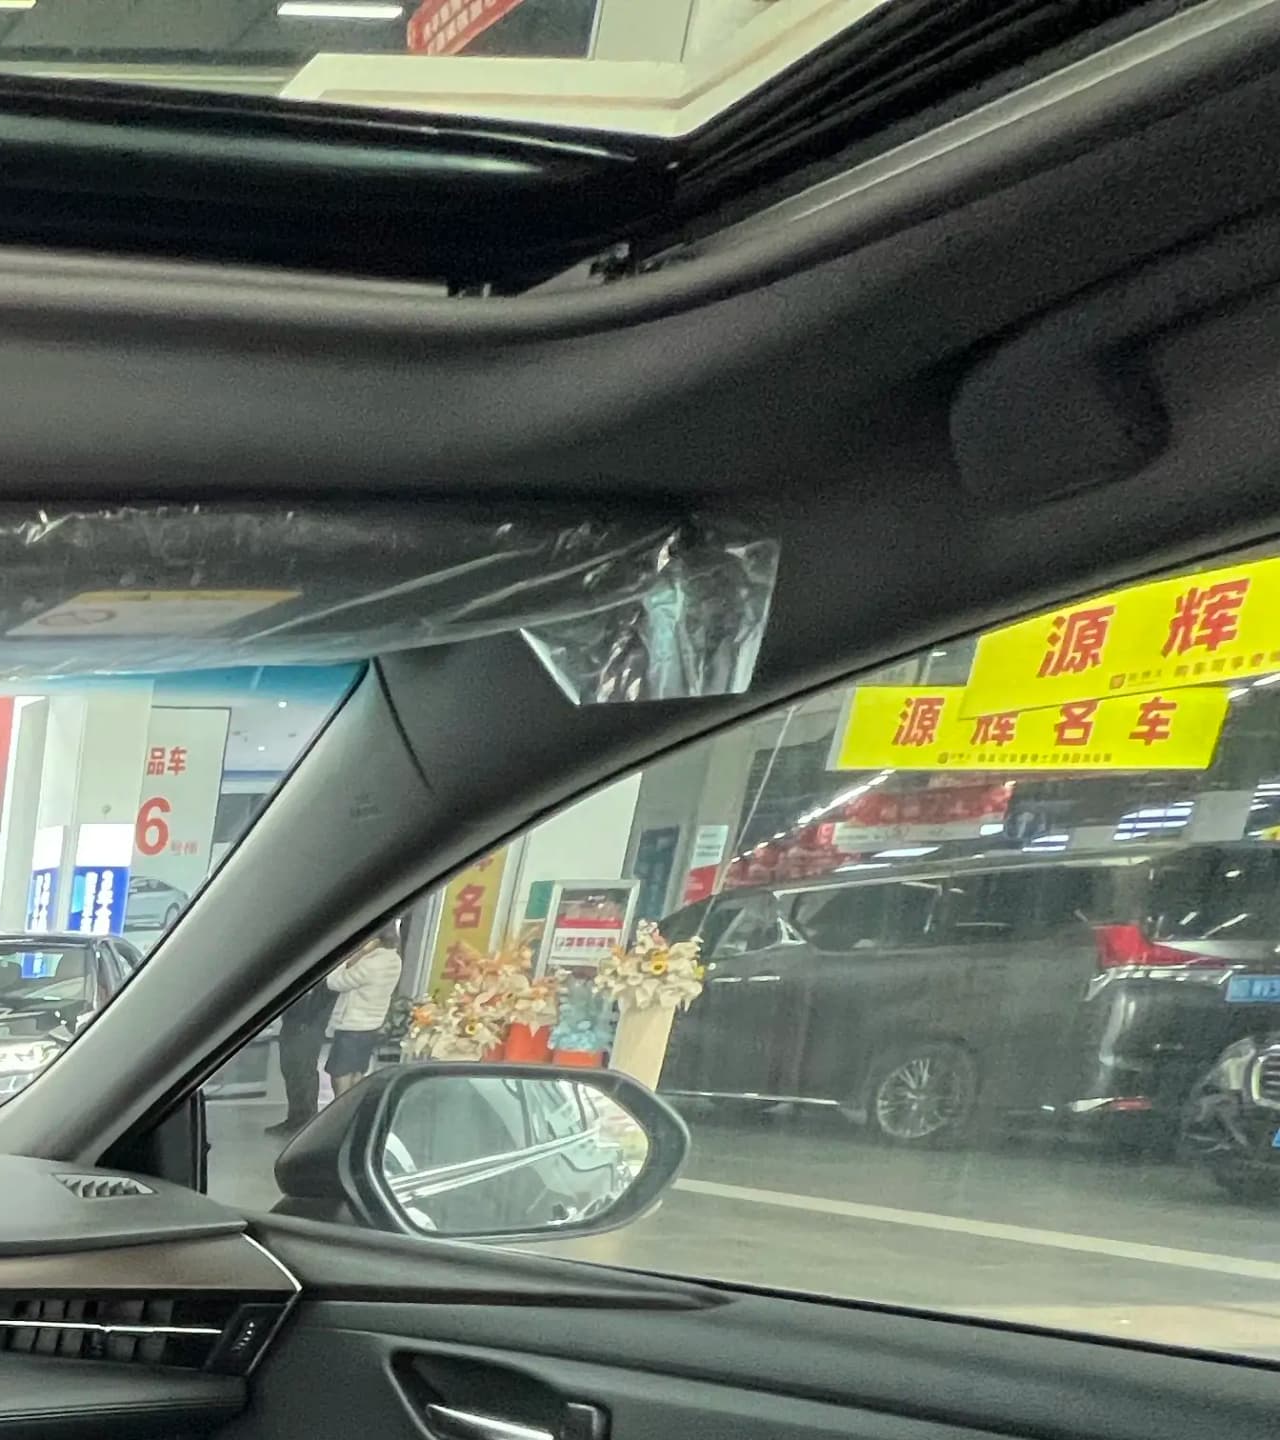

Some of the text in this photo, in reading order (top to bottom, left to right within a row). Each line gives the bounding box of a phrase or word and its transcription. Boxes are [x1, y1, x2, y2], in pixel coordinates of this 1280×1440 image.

[1036, 578, 1251, 679] 源辉
[892, 696, 1177, 748] 源辉名车
[135, 797, 171, 857] 6
